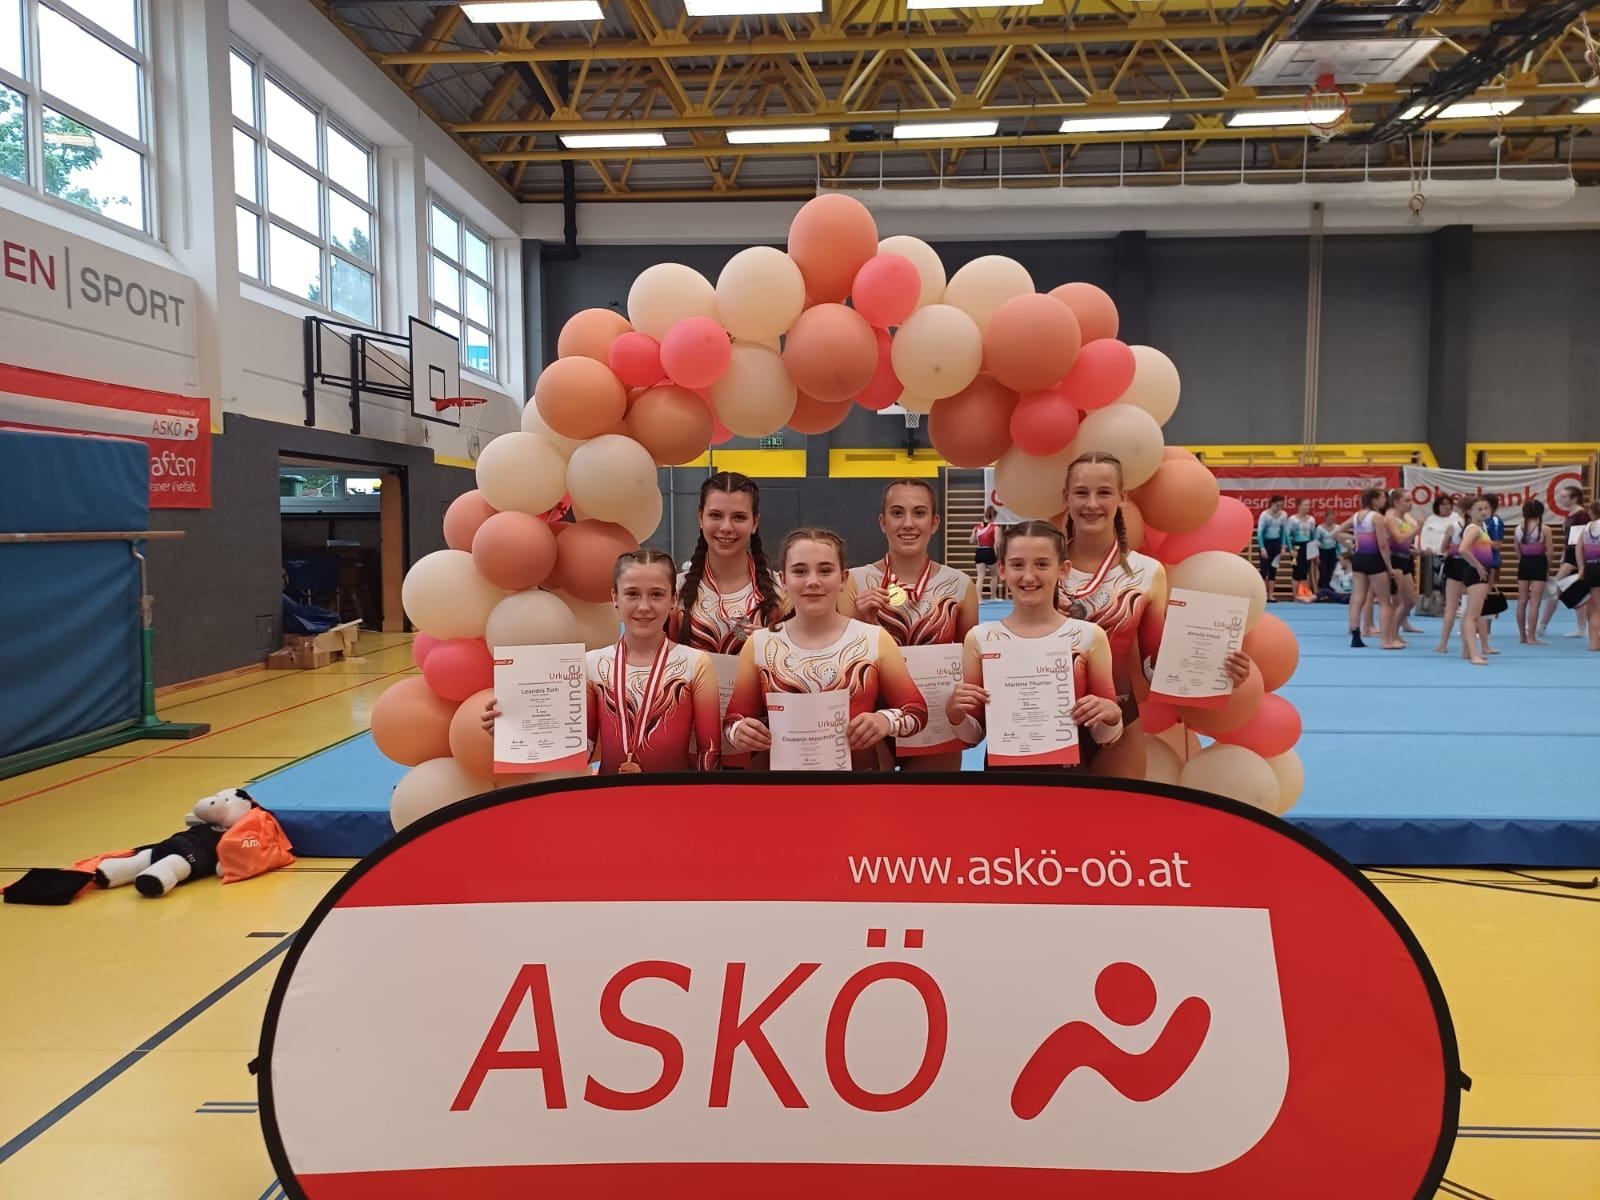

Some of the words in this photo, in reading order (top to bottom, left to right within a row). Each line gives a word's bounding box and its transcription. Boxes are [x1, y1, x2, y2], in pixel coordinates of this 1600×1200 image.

[3, 239, 56, 291] EN
[80, 266, 185, 327] SPORT
[151, 419, 182, 437] ASKÖ
[151, 450, 196, 477] aften
[549, 671, 583, 680] Urkunde
[564, 664, 583, 748] Urkunde
[1053, 658, 1073, 741] Urkunde
[848, 847, 1192, 888] www.askö-oö.at
[449, 928, 948, 1112] ASKÖ
